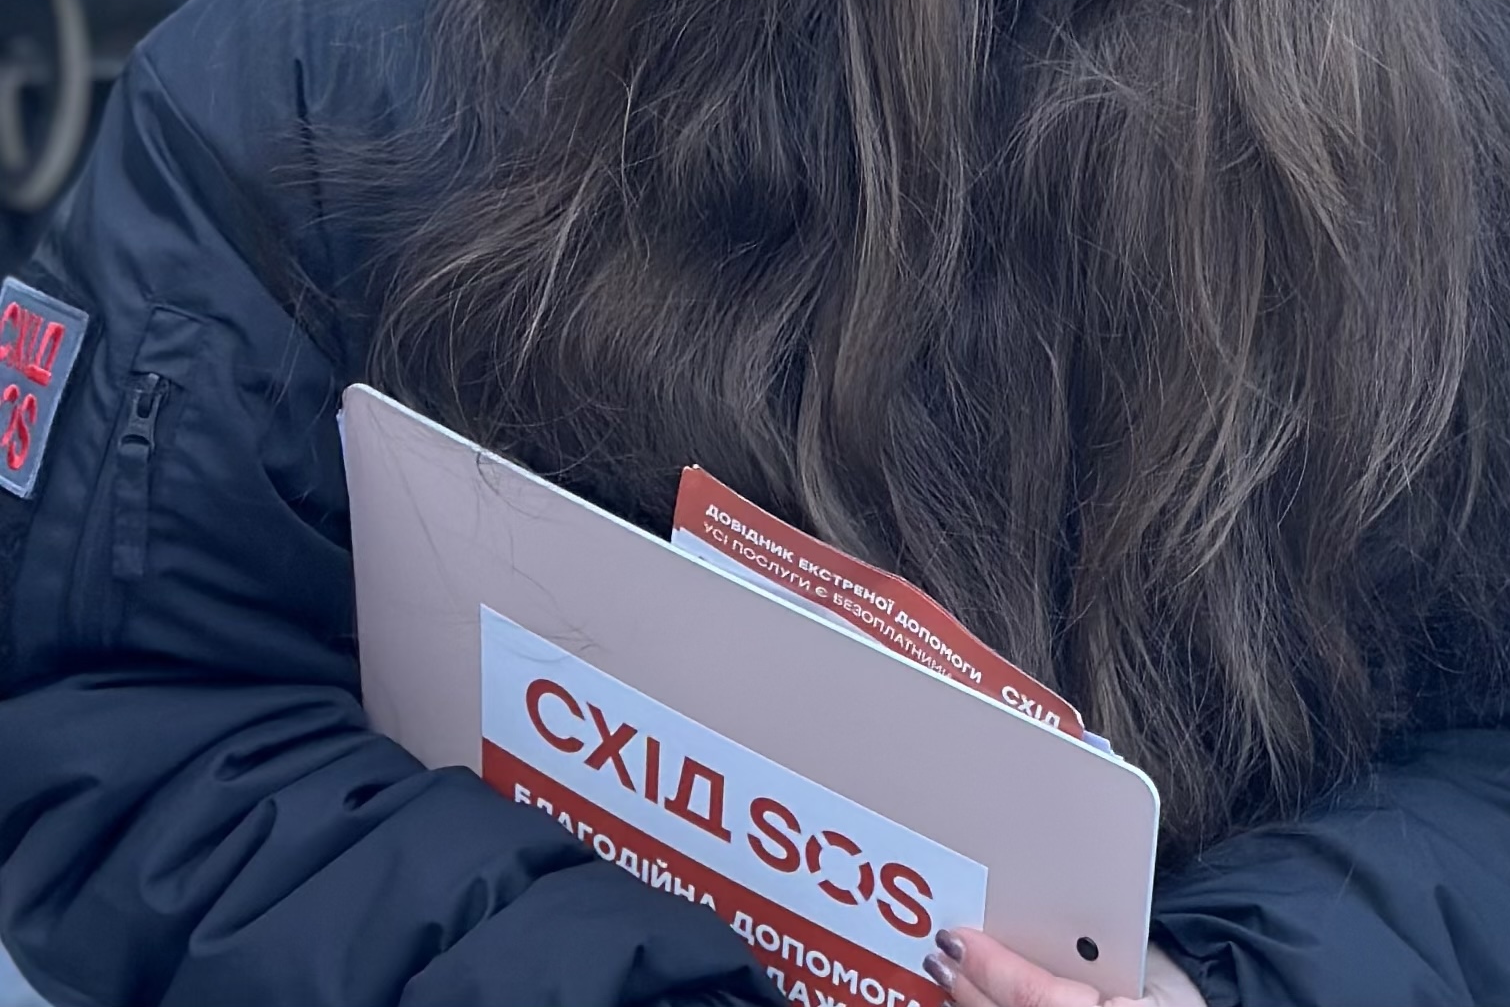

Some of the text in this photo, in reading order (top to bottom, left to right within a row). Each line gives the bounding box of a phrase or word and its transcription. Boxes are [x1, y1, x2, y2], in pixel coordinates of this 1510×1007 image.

[703, 521, 728, 545] УСІ
[732, 540, 810, 591] ПОСЛУГИ
[815, 586, 828, 599] Є
[705, 504, 982, 684] ДОВІДНИК ЕКСТРЕНОЇ ДОПОМОГИ
[1001, 685, 1061, 730] СХІД
[525, 678, 934, 938] СХІД SOS
[730, 910, 922, 1007] ДОПОМОГ
